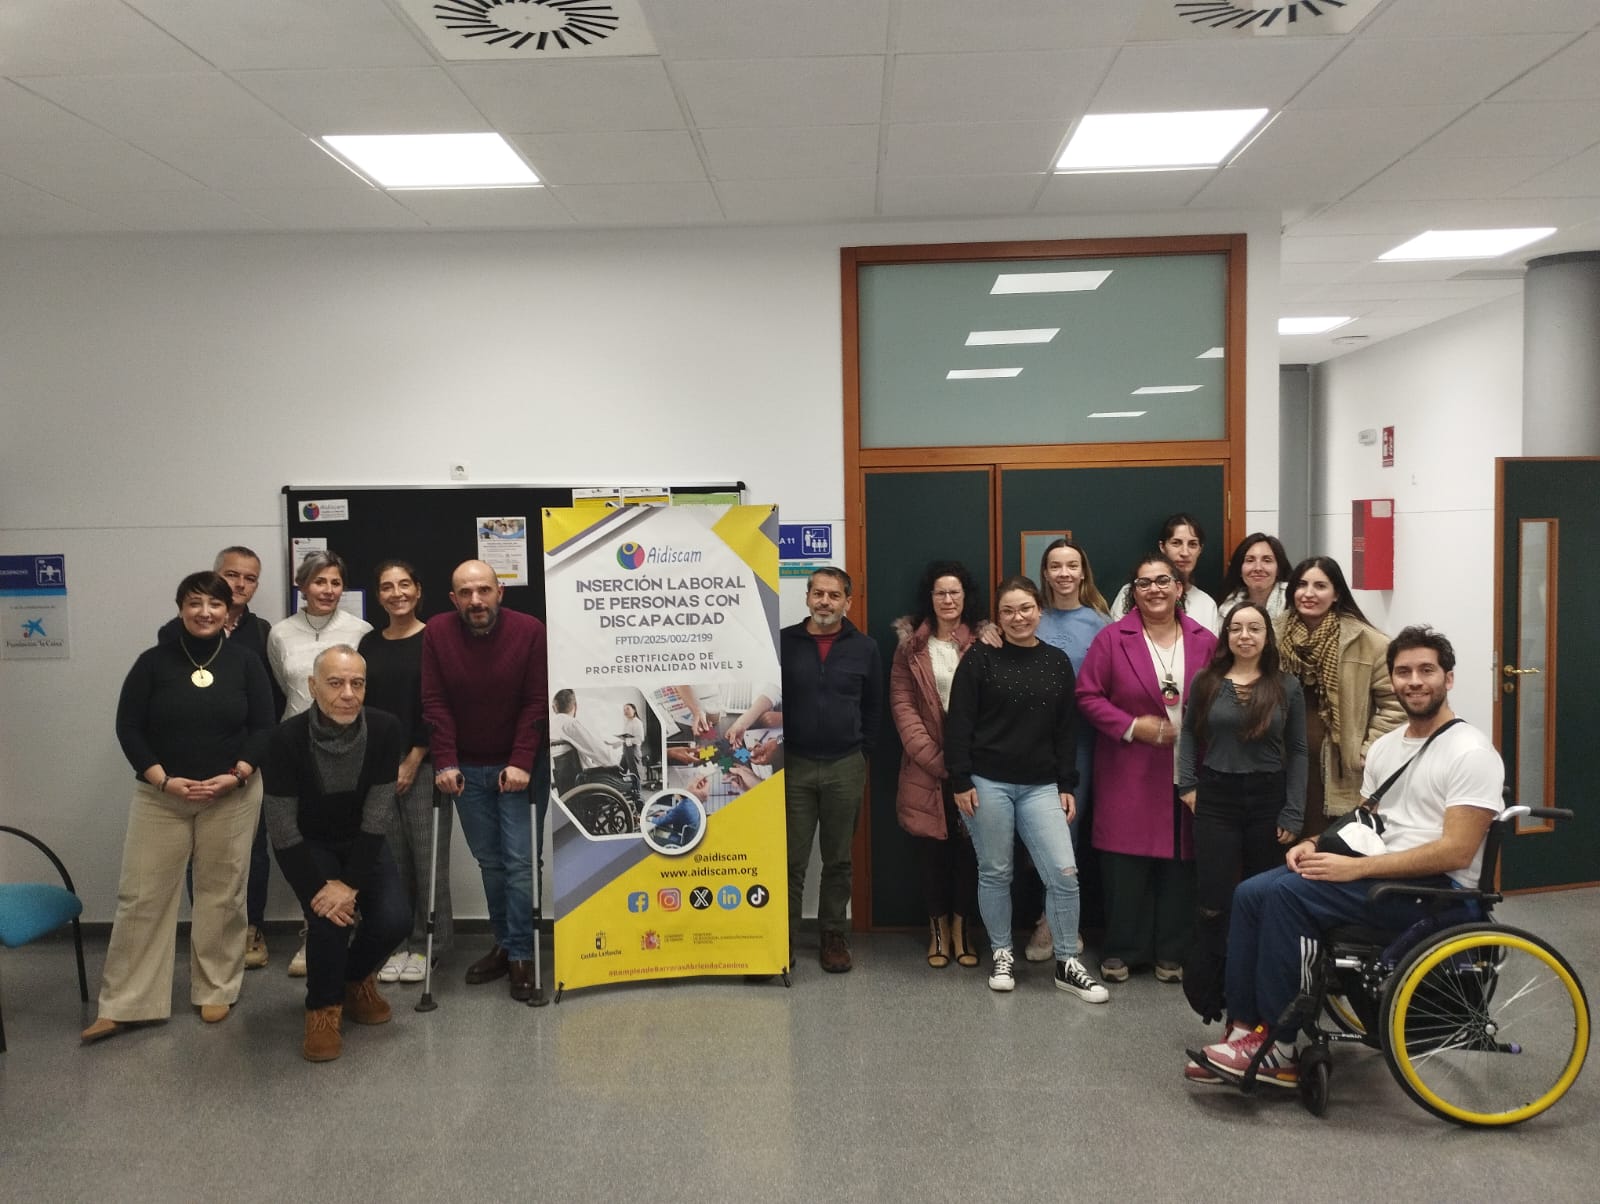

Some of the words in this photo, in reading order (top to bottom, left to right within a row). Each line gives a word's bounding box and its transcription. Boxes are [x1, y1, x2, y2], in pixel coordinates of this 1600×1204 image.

[787, 537, 796, 545] 11
[647, 545, 702, 564] Aidiscam
[576, 575, 663, 593] INSERCIÓN
[667, 576, 746, 590] LABORAL
[583, 597, 605, 611] DE
[610, 595, 700, 610] PERSONAS
[704, 594, 740, 607] CON
[600, 612, 725, 628] DISCAPACIDAD
[615, 633, 713, 645] FPTD/2025/002/2199
[615, 653, 695, 664] CERTIFICADO
[699, 652, 714, 661] DE
[585, 662, 697, 675] PROFESIONALIDAD
[700, 661, 734, 671] NIVEL
[736, 660, 743, 669] 3
[693, 852, 747, 863] @aidiscam
[660, 866, 758, 878] www.aidiscam.org
